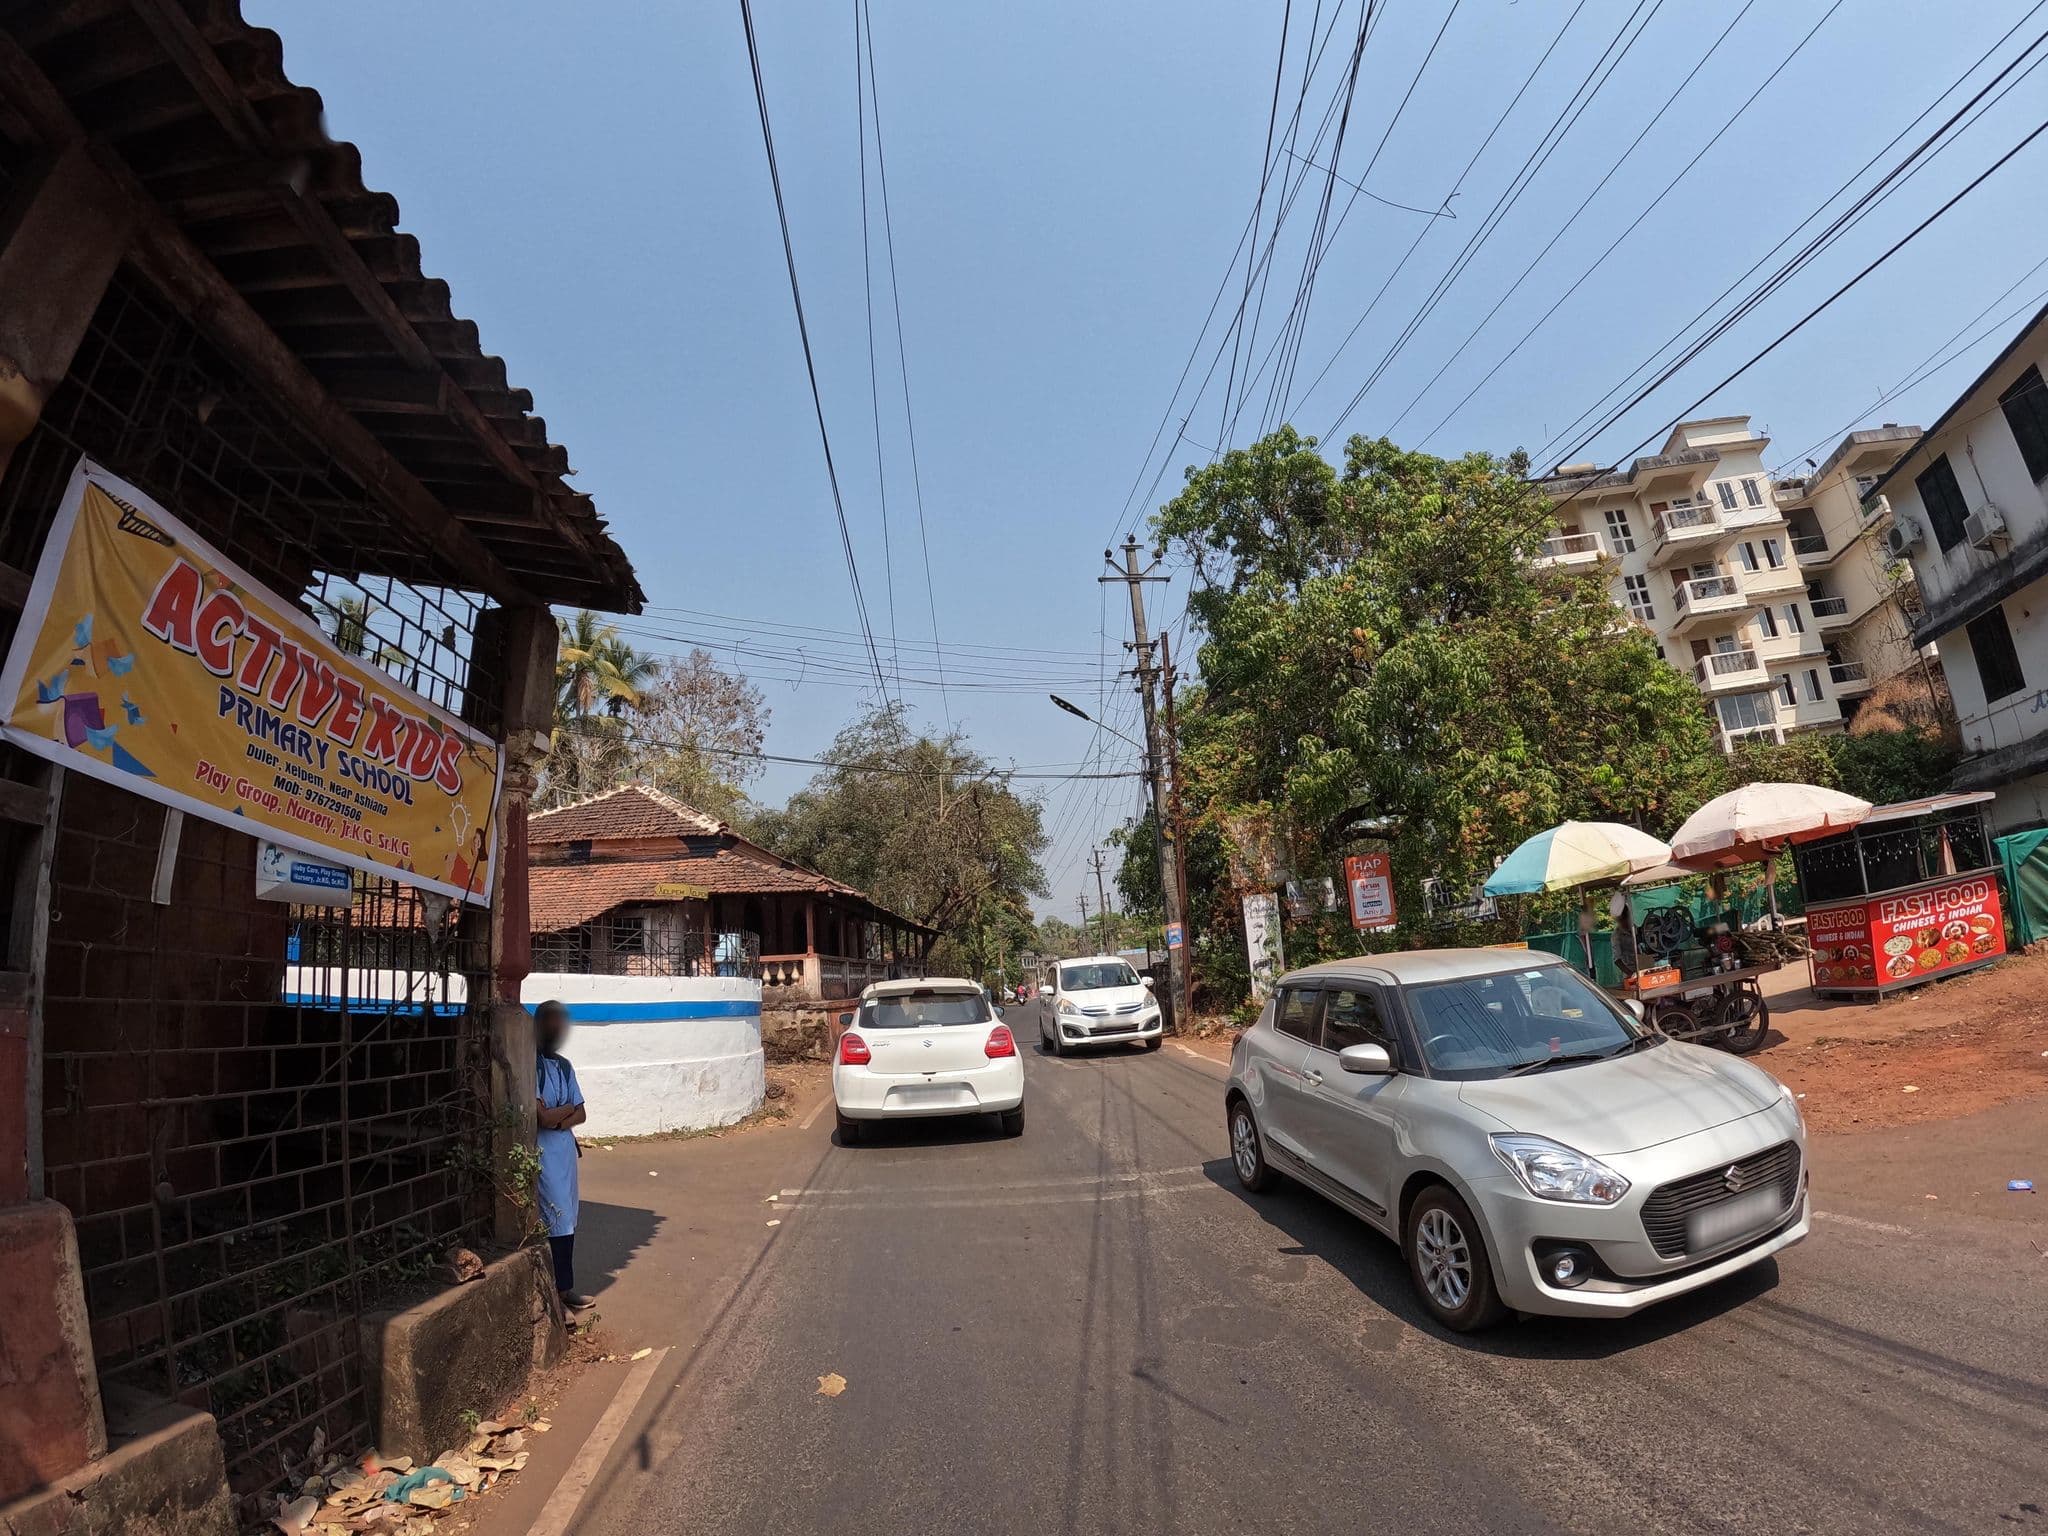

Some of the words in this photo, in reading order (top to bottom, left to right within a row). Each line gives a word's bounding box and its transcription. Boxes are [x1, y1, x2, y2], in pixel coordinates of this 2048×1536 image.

[142, 557, 365, 748] ACTIVE
[364, 693, 464, 796] KIDS
[218, 685, 329, 771] PRIMARY
[337, 750, 414, 806] SCHOOL
[194, 759, 232, 794] Play
[235, 777, 281, 814] Group,
[286, 797, 336, 835] Nursery,
[273, 774, 303, 796] Mob:
[304, 789, 363, 821] 9767291506
[354, 792, 389, 816] Ashiana
[1354, 859, 1381, 871] HAP
[1810, 913, 1835, 930] FAST
[1834, 908, 1866, 929] FOOD
[1881, 893, 1934, 924] FAST
[1934, 880, 1989, 912] FOOD
[1892, 916, 1936, 934] CHINESE
[1938, 912, 1945, 922] &
[1948, 903, 1983, 920] INDIAN
[1816, 933, 1838, 943] CHINESE
[1844, 930, 1865, 940] INDIAN
